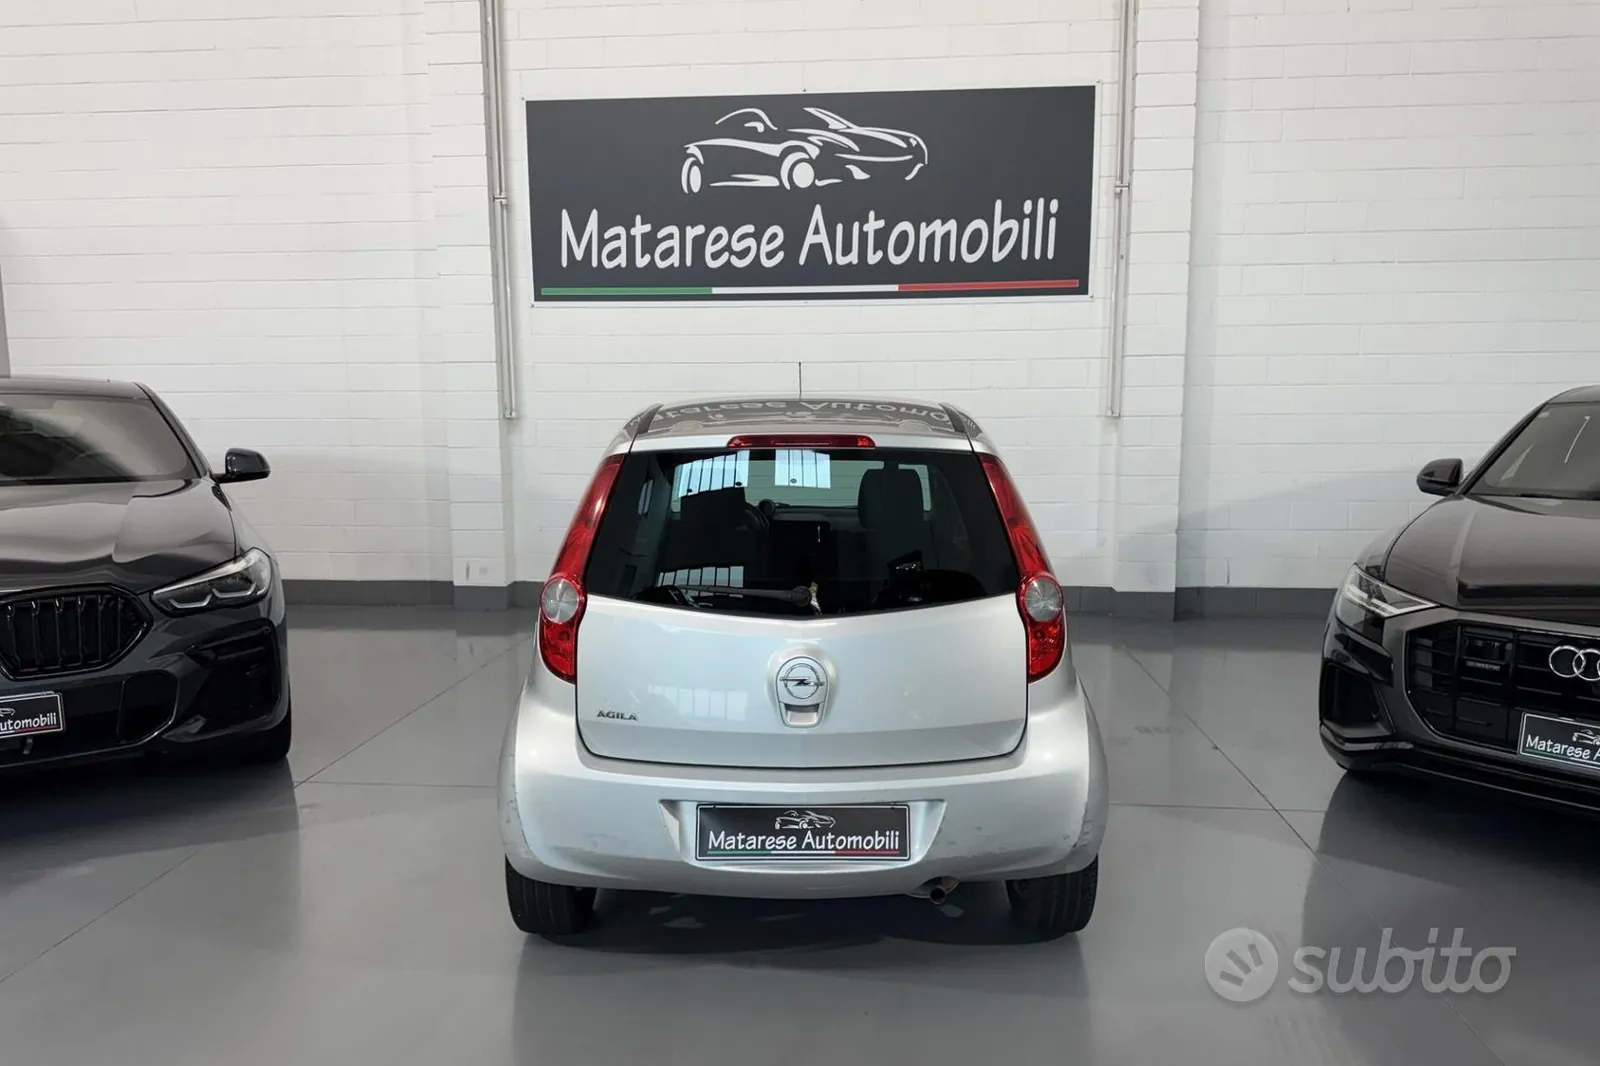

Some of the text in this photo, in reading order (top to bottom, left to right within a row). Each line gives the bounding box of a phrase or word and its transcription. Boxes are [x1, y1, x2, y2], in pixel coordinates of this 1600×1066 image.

[560, 197, 1059, 269] Matarese Automobili
[0, 712, 57, 731] utomobili
[596, 710, 638, 721] AGILA
[1525, 734, 1591, 759] Matarese
[707, 831, 900, 850] Matarese Automobili
